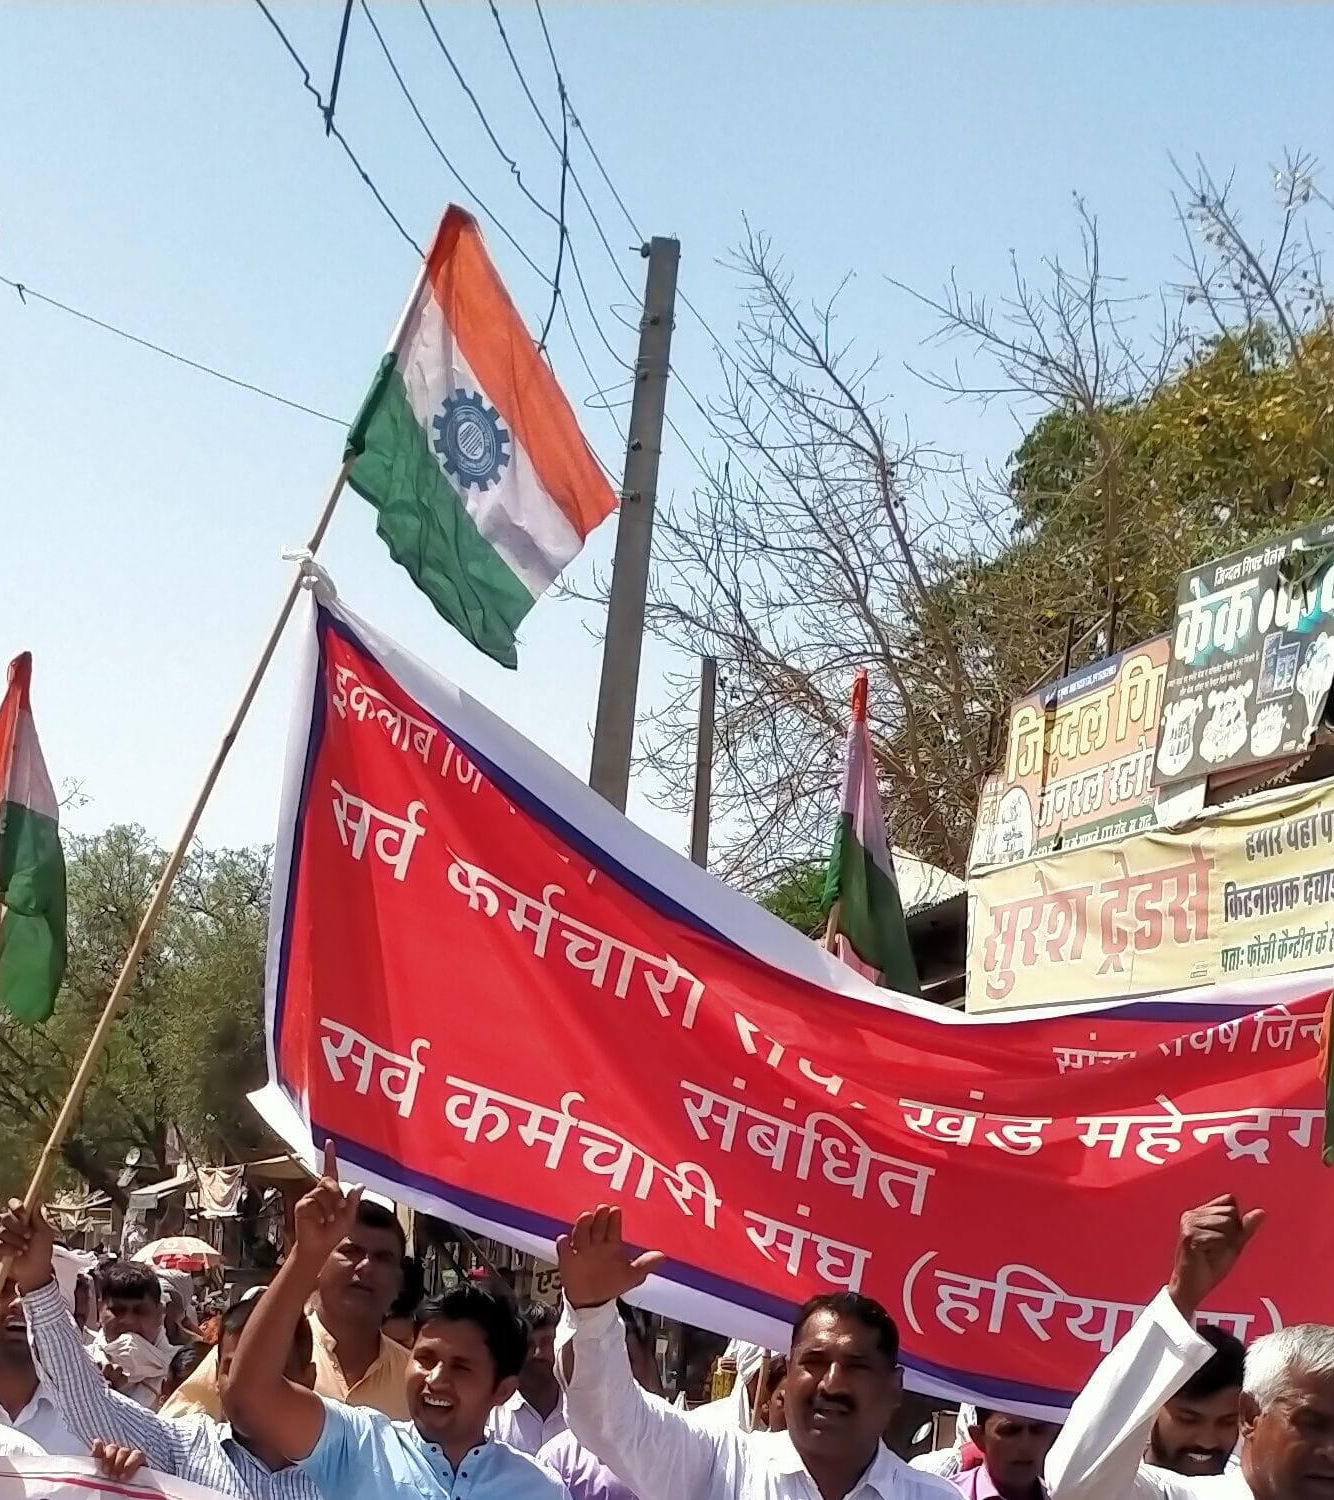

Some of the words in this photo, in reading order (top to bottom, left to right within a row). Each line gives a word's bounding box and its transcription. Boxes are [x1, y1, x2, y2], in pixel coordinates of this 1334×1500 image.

[330, 777, 429, 883] सर्व
[983, 870, 1094, 1001] सुरेश
[318, 1016, 432, 1120] सर्व
[443, 1074, 724, 1230] कर्मचारी
[743, 1204, 873, 1294] संघ
[679, 1074, 937, 1217] संबंधित
[898, 1088, 1053, 1157] खंड
